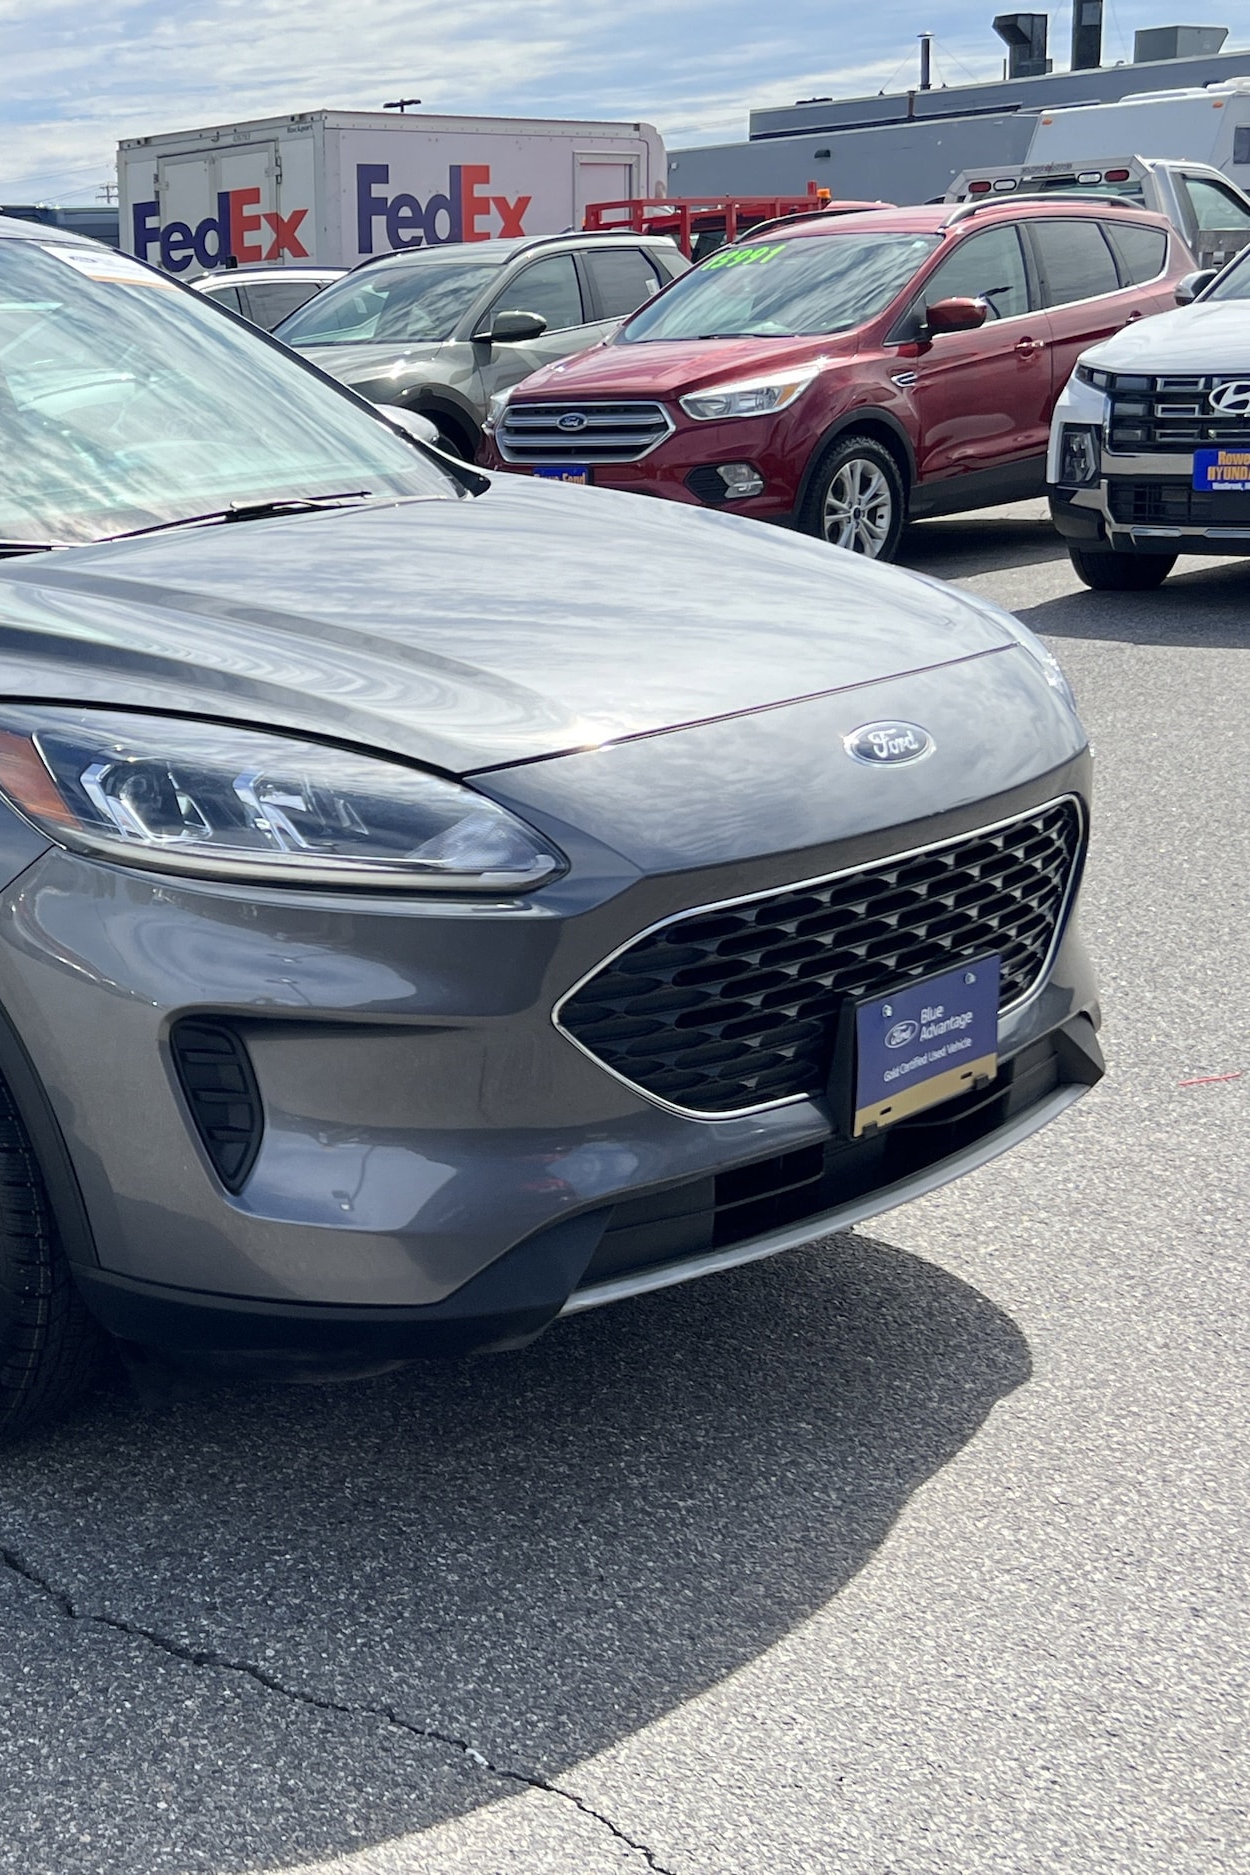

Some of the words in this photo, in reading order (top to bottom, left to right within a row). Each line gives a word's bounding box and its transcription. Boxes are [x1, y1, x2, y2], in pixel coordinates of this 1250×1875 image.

[356, 164, 532, 250] FedEx
[132, 187, 308, 272] FedEx
[1207, 466, 1250, 481] HYUND
[868, 728, 919, 758] Ford
[919, 1011, 973, 1042] Advantage
[920, 1005, 945, 1025] Blue
[899, 1052, 928, 1074] Certified
[928, 1045, 947, 1062] Used
[946, 1037, 972, 1054] Vehicle
